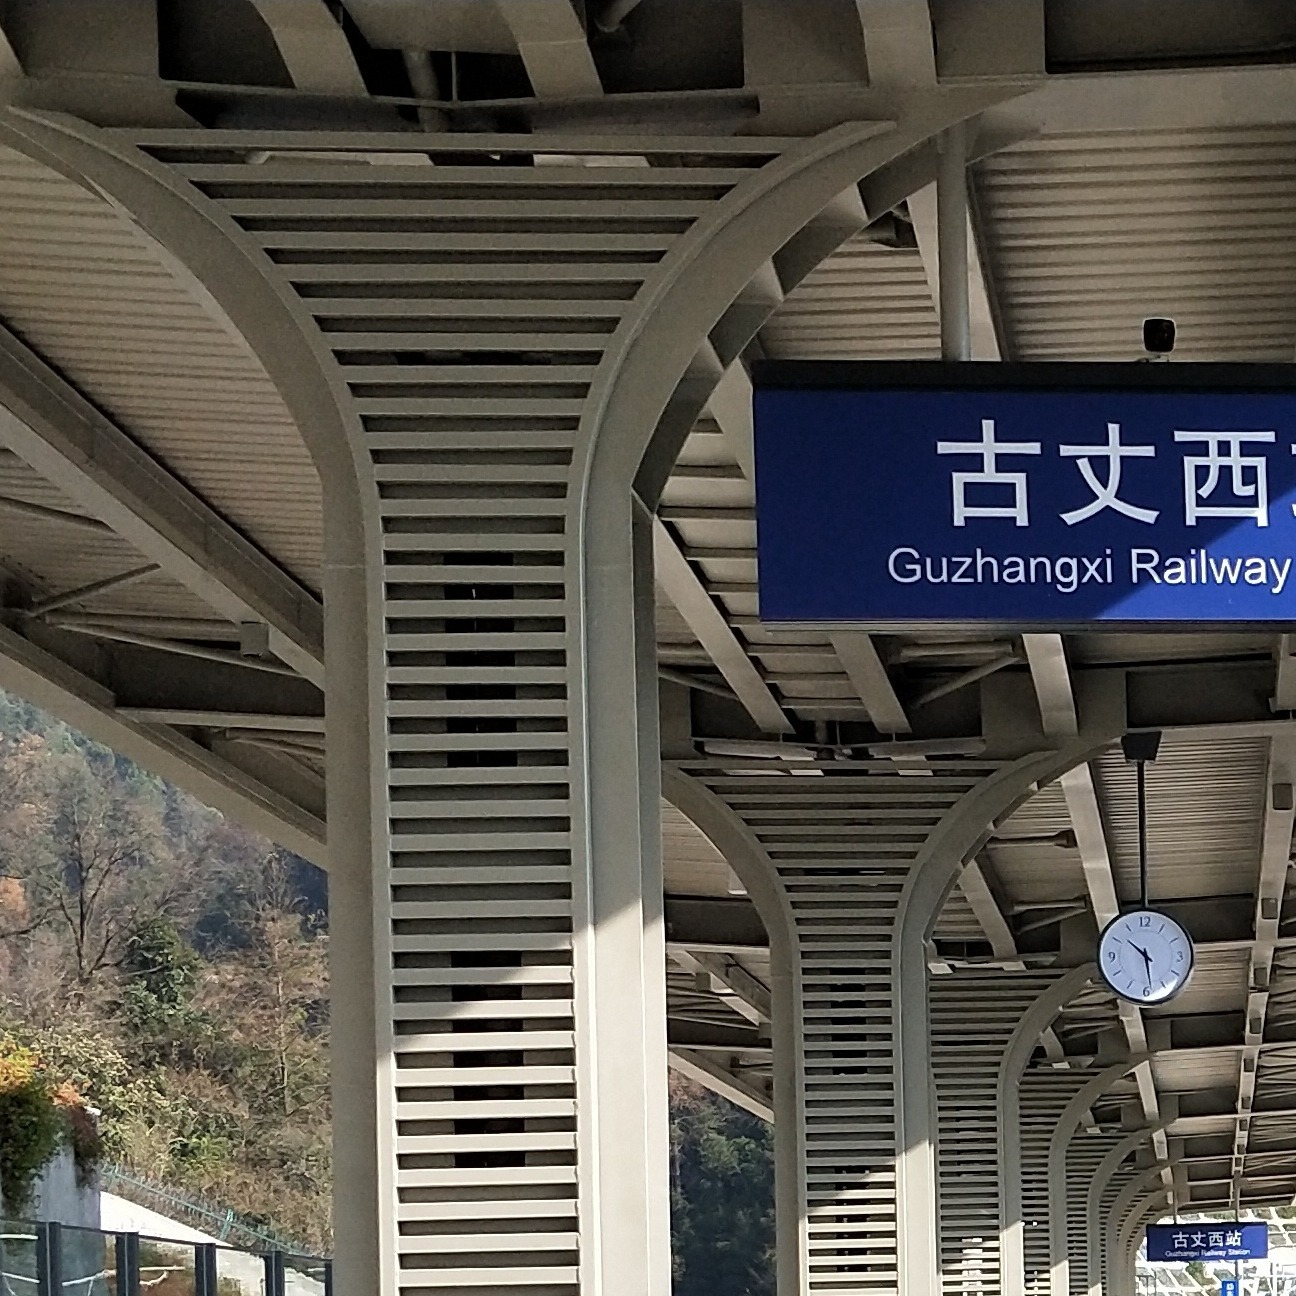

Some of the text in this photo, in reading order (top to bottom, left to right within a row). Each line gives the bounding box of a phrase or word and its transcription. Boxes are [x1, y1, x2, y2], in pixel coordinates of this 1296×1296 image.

[888, 547, 1113, 593] Guzhangxi
[1131, 548, 1292, 594] Railway
[1139, 916, 1152, 928] 12
[1108, 951, 1116, 963] 9
[1176, 950, 1184, 962] 3
[1142, 986, 1151, 997] 6
[1172, 1230, 1242, 1249] 古丈西站
